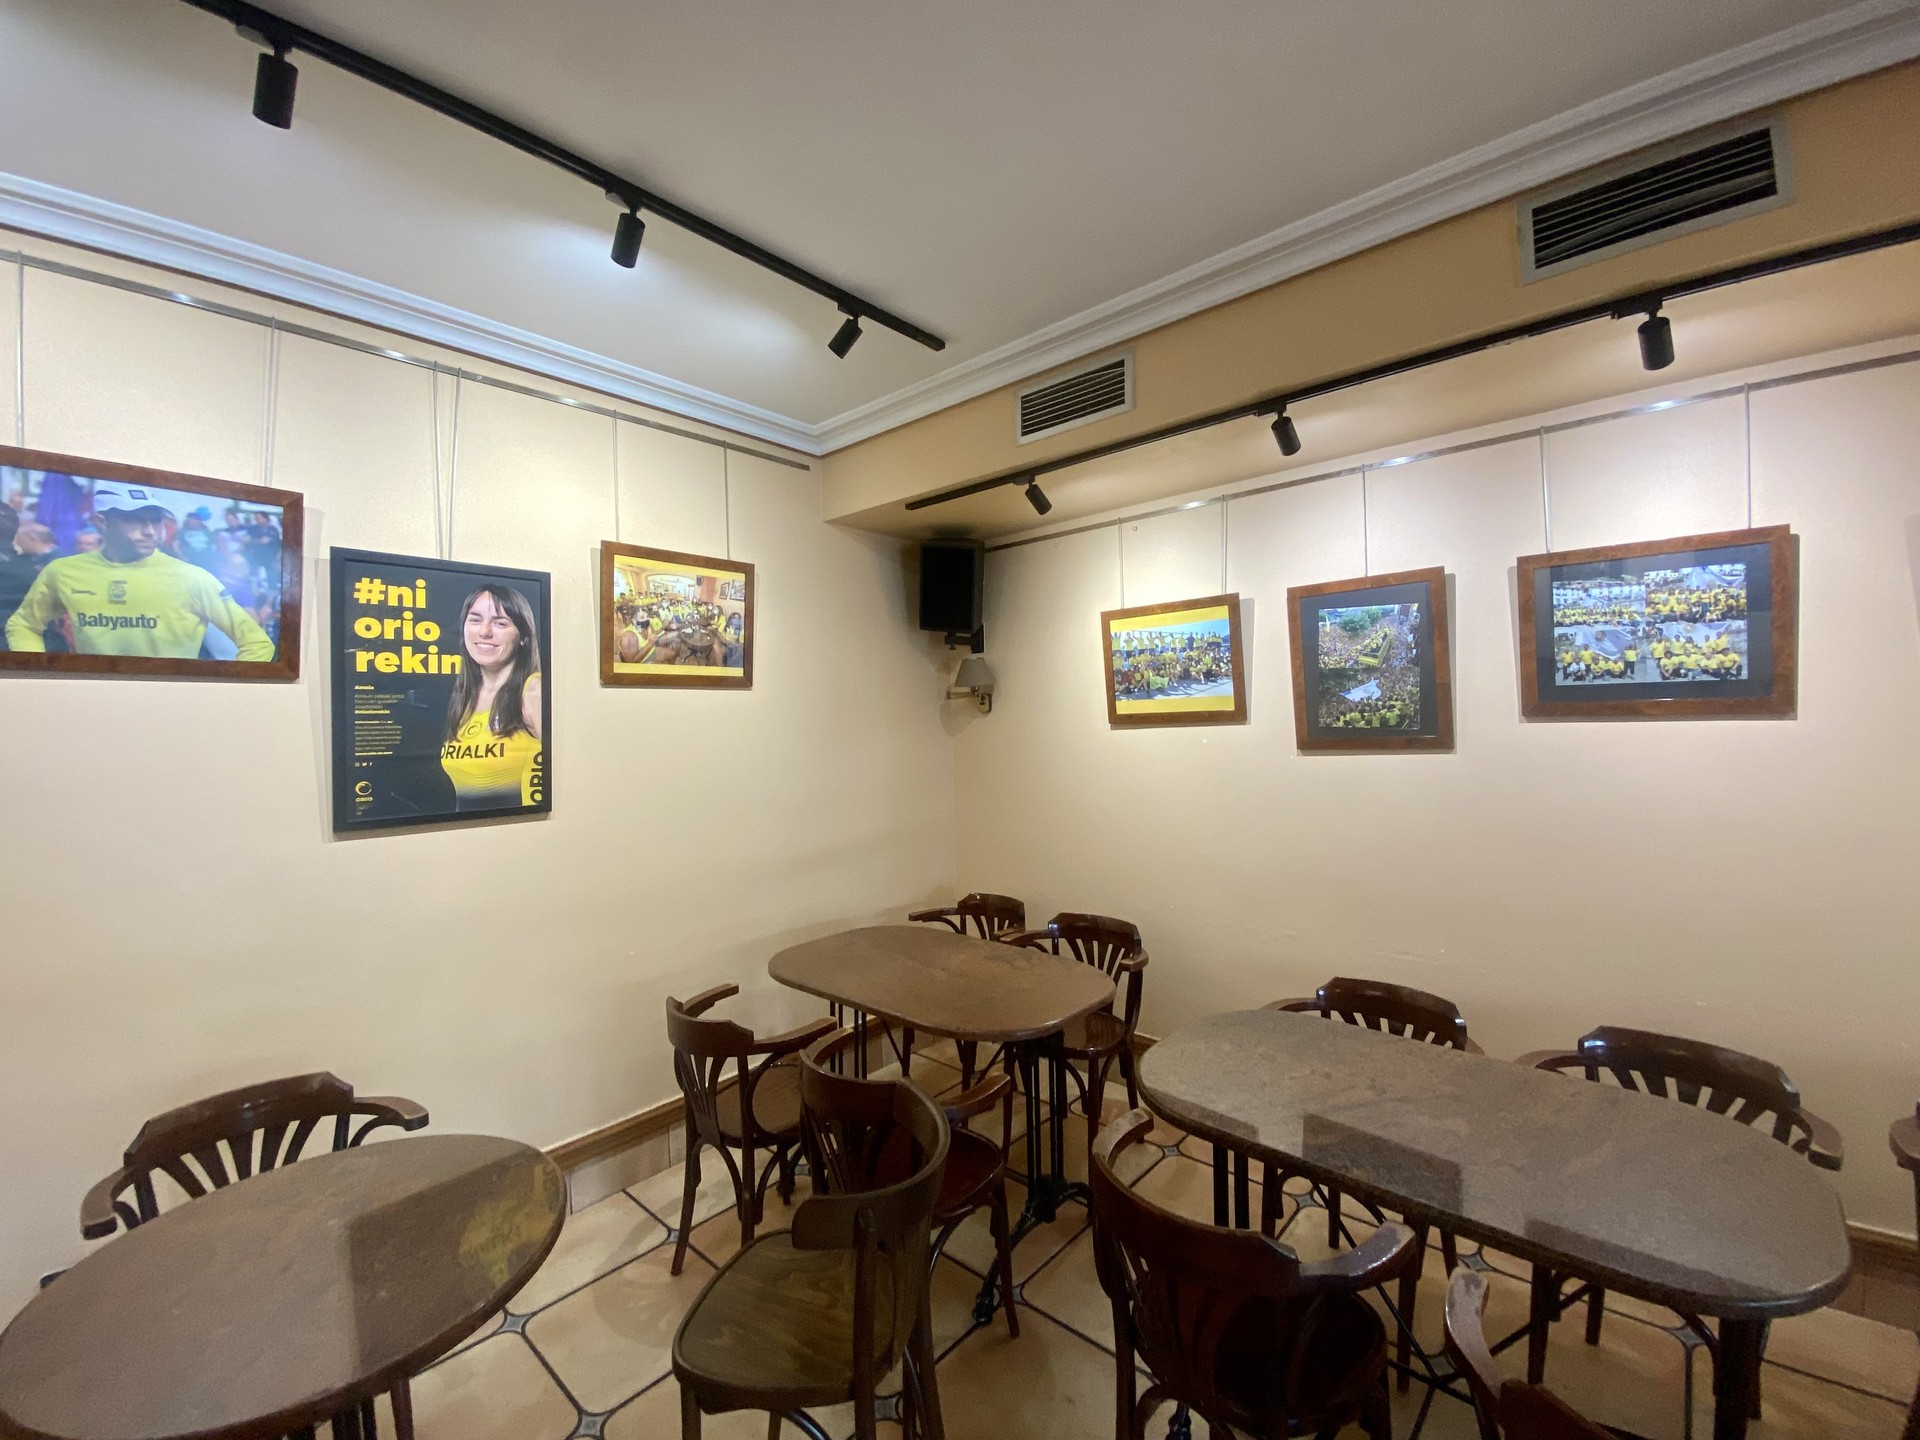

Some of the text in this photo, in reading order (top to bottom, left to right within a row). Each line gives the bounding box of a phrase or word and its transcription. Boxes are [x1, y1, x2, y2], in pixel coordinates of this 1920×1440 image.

[354, 577, 426, 608] #ni
[77, 612, 157, 630] Babyauto
[354, 610, 440, 642] orio
[356, 645, 462, 675] rekin
